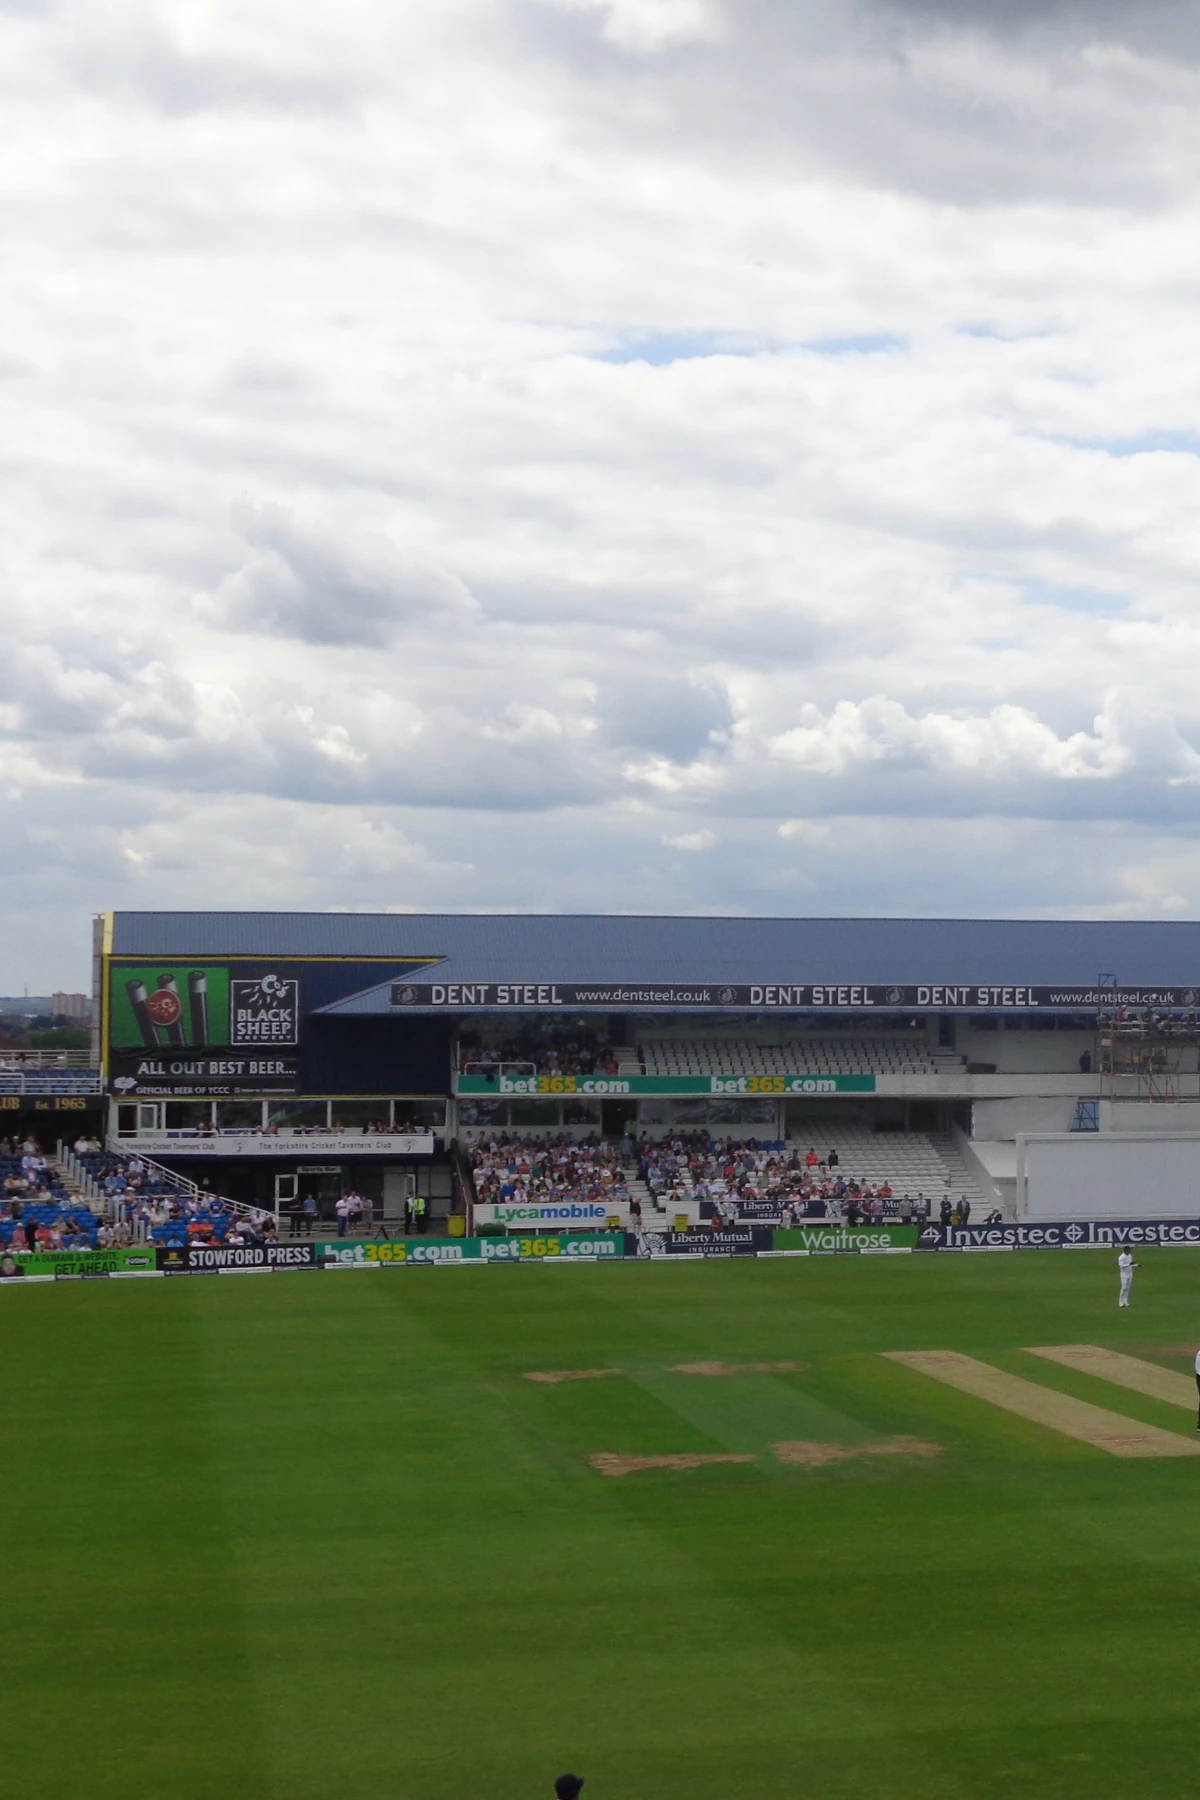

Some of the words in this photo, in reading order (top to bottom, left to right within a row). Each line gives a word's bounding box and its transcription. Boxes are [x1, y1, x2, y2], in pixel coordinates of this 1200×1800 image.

[431, 985, 489, 1004] DENT
[496, 985, 563, 1004] STEEL
[575, 988, 711, 1003] www.dentsteel.co.uk
[750, 986, 805, 1005] DENT
[812, 986, 874, 1005] STEEL
[917, 987, 971, 1006] DENT
[977, 987, 1039, 1006] STEEL
[237, 1009, 292, 1022] BLACK
[237, 1022, 292, 1035] SHEEP
[137, 1061, 166, 1075] ALL
[170, 1061, 205, 1075] OUT
[209, 1061, 245, 1075] BEST
[249, 1061, 297, 1075] BEER...
[135, 1086, 172, 1095] OFFICIAL
[174, 1086, 194, 1094] BEER
[194, 1086, 207, 1094] OF
[208, 1086, 230, 1094] YCCC
[500, 1076, 630, 1094] bet365.com
[710, 1076, 837, 1093] bet365.com
[54, 1097, 87, 1110] 1965
[152, 1142, 172, 1150] Cricket
[202, 1142, 216, 1150] Club
[259, 1142, 272, 1150] The
[274, 1142, 309, 1150] Yorkshire
[310, 1142, 337, 1150] Cricket
[375, 1141, 392, 1149] Club
[493, 1204, 606, 1222] Lycamobile
[743, 1202, 773, 1213] Liberty
[671, 1232, 711, 1246] Liberty
[712, 1231, 753, 1243] Mutual
[801, 1230, 891, 1250] Waitrose
[945, 1225, 1060, 1247] Investec
[1088, 1222, 1200, 1244] Investec
[324, 1243, 463, 1263] bet365.com
[480, 1238, 615, 1258] bet365.com
[19, 1254, 33, 1264] GET
[34, 1254, 41, 1263] A
[42, 1253, 74, 1262] DOMAIN
[188, 1248, 264, 1267] STOWFORD
[267, 1246, 311, 1263] PRESS
[54, 1263, 77, 1275] GET
